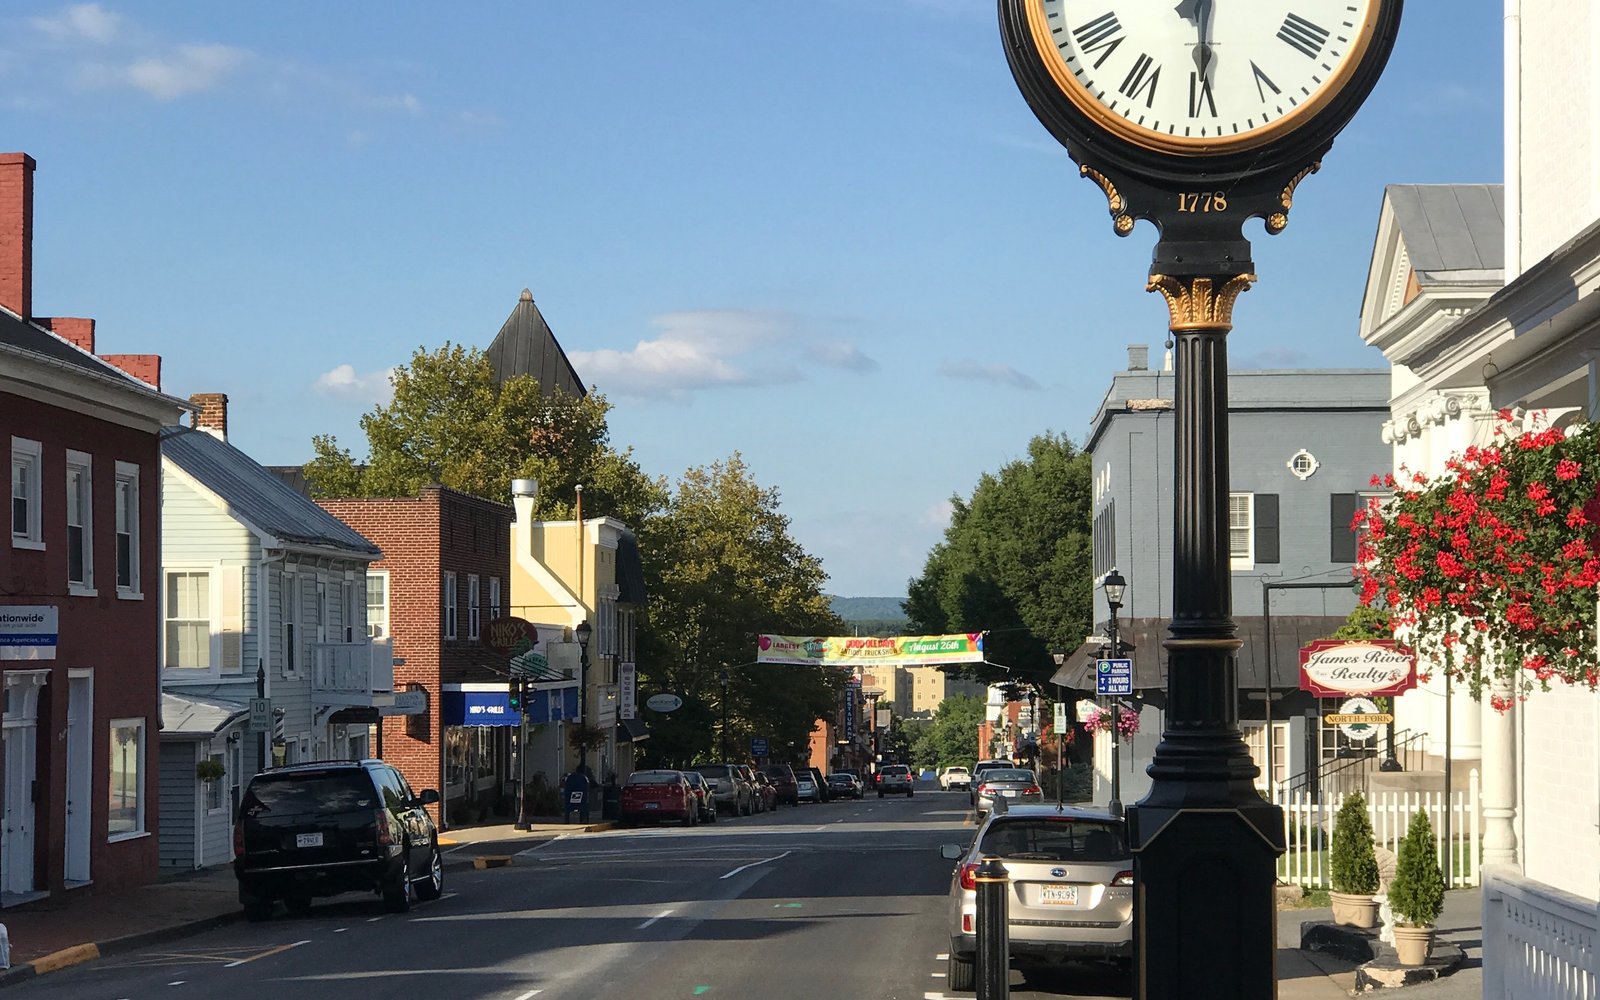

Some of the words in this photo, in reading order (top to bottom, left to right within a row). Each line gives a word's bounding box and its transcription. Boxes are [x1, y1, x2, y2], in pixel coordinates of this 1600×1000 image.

[1178, 193, 1228, 212] 1778
[490, 623, 527, 637] NIKO'S
[908, 642, 938, 653] August
[940, 641, 959, 650] 26th
[1304, 651, 1360, 669] James
[1363, 650, 1412, 664] River
[1330, 667, 1389, 683] Realty
[255, 702, 266, 713] 10
